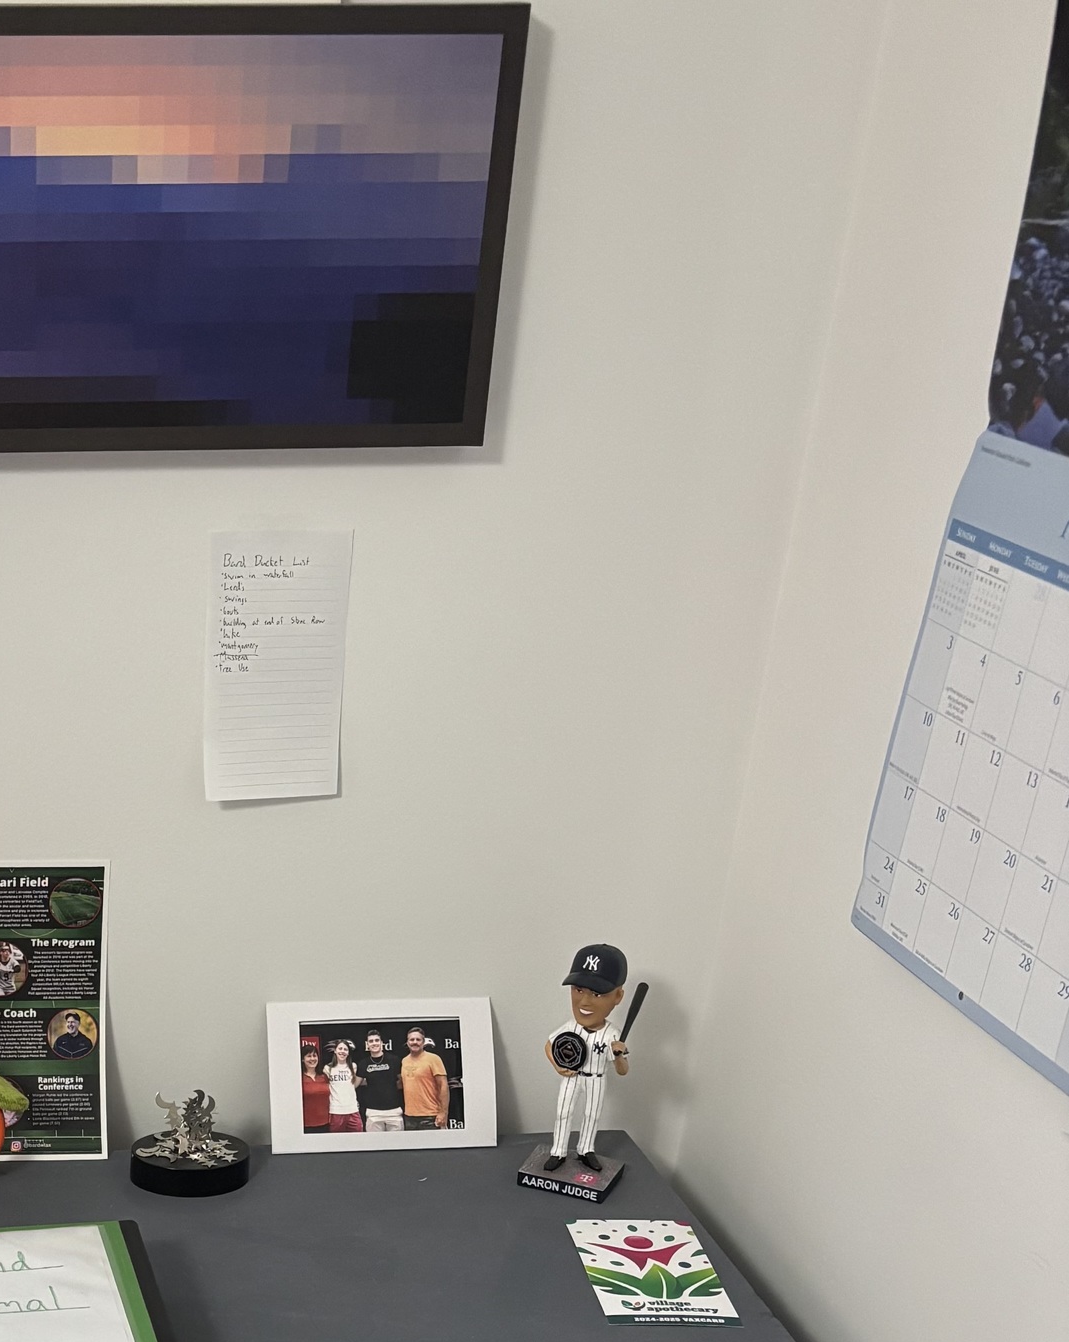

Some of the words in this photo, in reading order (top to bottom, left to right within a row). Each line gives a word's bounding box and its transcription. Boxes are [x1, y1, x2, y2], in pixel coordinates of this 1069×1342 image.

[946, 636, 954, 650] 3
[980, 654, 987, 667] 4
[1015, 670, 1024, 686] 5
[1053, 690, 1061, 706] 6
[922, 711, 933, 727] 10
[955, 730, 966, 746] 11
[990, 750, 1002, 768] 12
[1026, 771, 1040, 789] 13
[903, 786, 914, 801] 17
[935, 806, 948, 824] 18
[970, 828, 982, 844] 19
[884, 858, 894, 874] 24
[1004, 850, 1017, 869] 20
[20, 876, 49, 888] Field
[915, 878, 928, 896] 25
[1041, 874, 1054, 894] 21
[875, 892, 886, 908] 31
[948, 902, 960, 921] 26
[30, 938, 50, 946] The
[52, 938, 95, 948] Program
[982, 926, 996, 946] 27
[1018, 952, 1033, 972] 28
[4, 1008, 36, 1018] Coach
[38, 1076, 74, 1084] Rankings
[522, 1175, 560, 1192] AARON
[561, 1184, 598, 1202] JUDGE
[646, 1306, 719, 1314] apothecary
